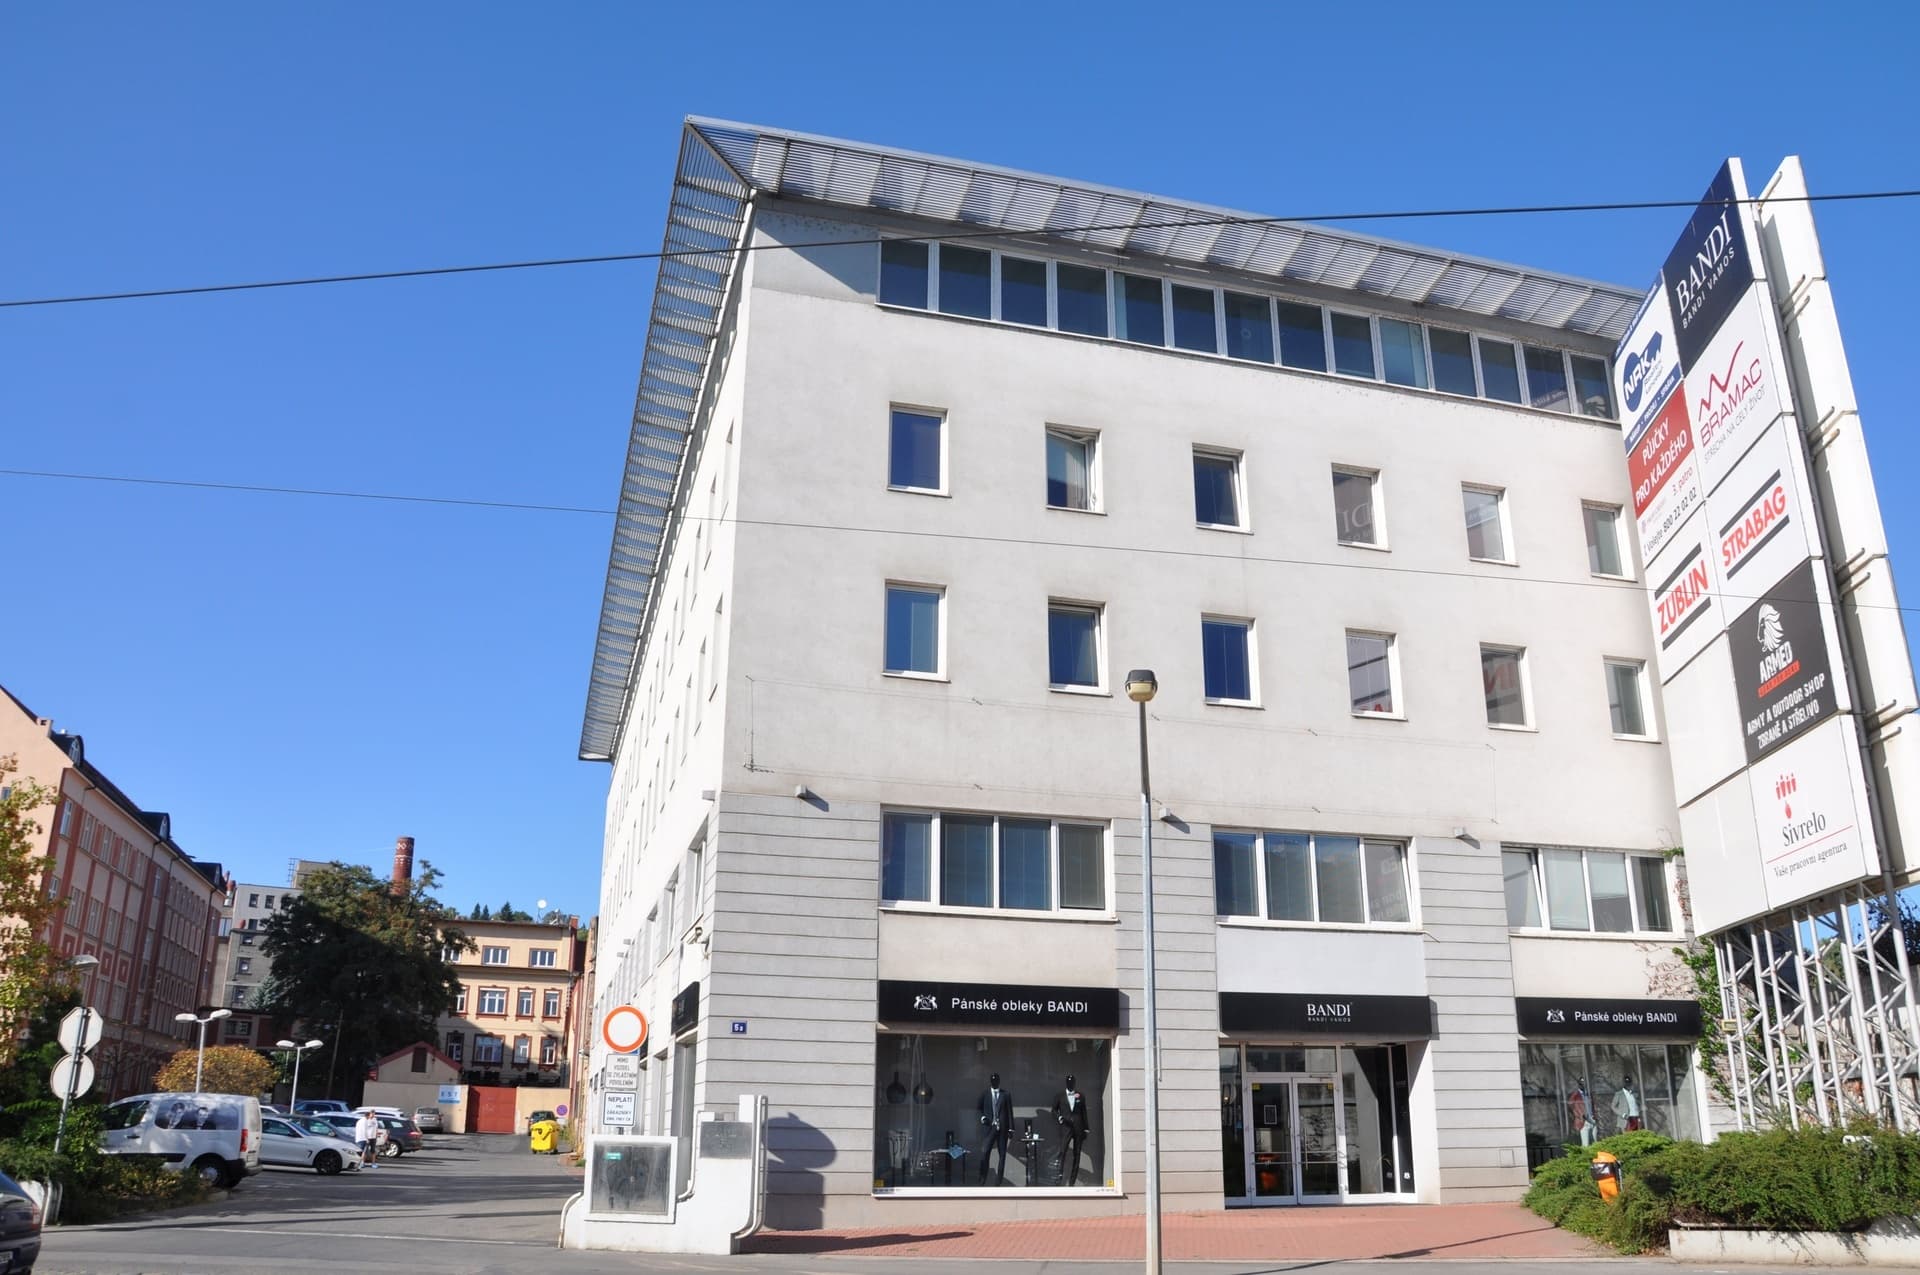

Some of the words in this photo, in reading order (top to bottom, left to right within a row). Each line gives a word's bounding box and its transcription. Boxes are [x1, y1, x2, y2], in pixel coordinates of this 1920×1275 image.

[1676, 209, 1733, 316] BANDI
[1682, 290, 1706, 329] BANDI
[1707, 247, 1735, 290] VAMOS
[1624, 349, 1651, 401] NRK
[1700, 358, 1762, 448] BRAMAC
[1642, 417, 1669, 466] PŮJČKY
[1635, 478, 1651, 508] PRO
[1650, 429, 1688, 488] KAŽDÉHO
[1679, 467, 1693, 489] patro
[1673, 505, 1681, 520] 22
[1681, 496, 1689, 512] 02
[1689, 487, 1697, 501] 02
[1721, 486, 1786, 567] STRABAG
[1760, 641, 1793, 684] ARMED
[1747, 712, 1765, 736] ARMY
[1766, 708, 1773, 723] A
[1772, 688, 1804, 718] OUTDOOR
[1803, 672, 1825, 697] SHOP
[1782, 719, 1788, 734] A
[1788, 699, 1820, 730] STŘELIVO
[1782, 812, 1826, 847] Sivrelo
[1818, 842, 1848, 863] agentura
[951, 997, 998, 1011] Pánské
[1001, 999, 1043, 1014] obleky
[1047, 1001, 1088, 1013] BANDI
[1307, 1003, 1351, 1017] BANDI
[1574, 1011, 1610, 1022] Pánské
[1612, 1011, 1643, 1024] obleky
[1646, 1012, 1678, 1023] BANDI
